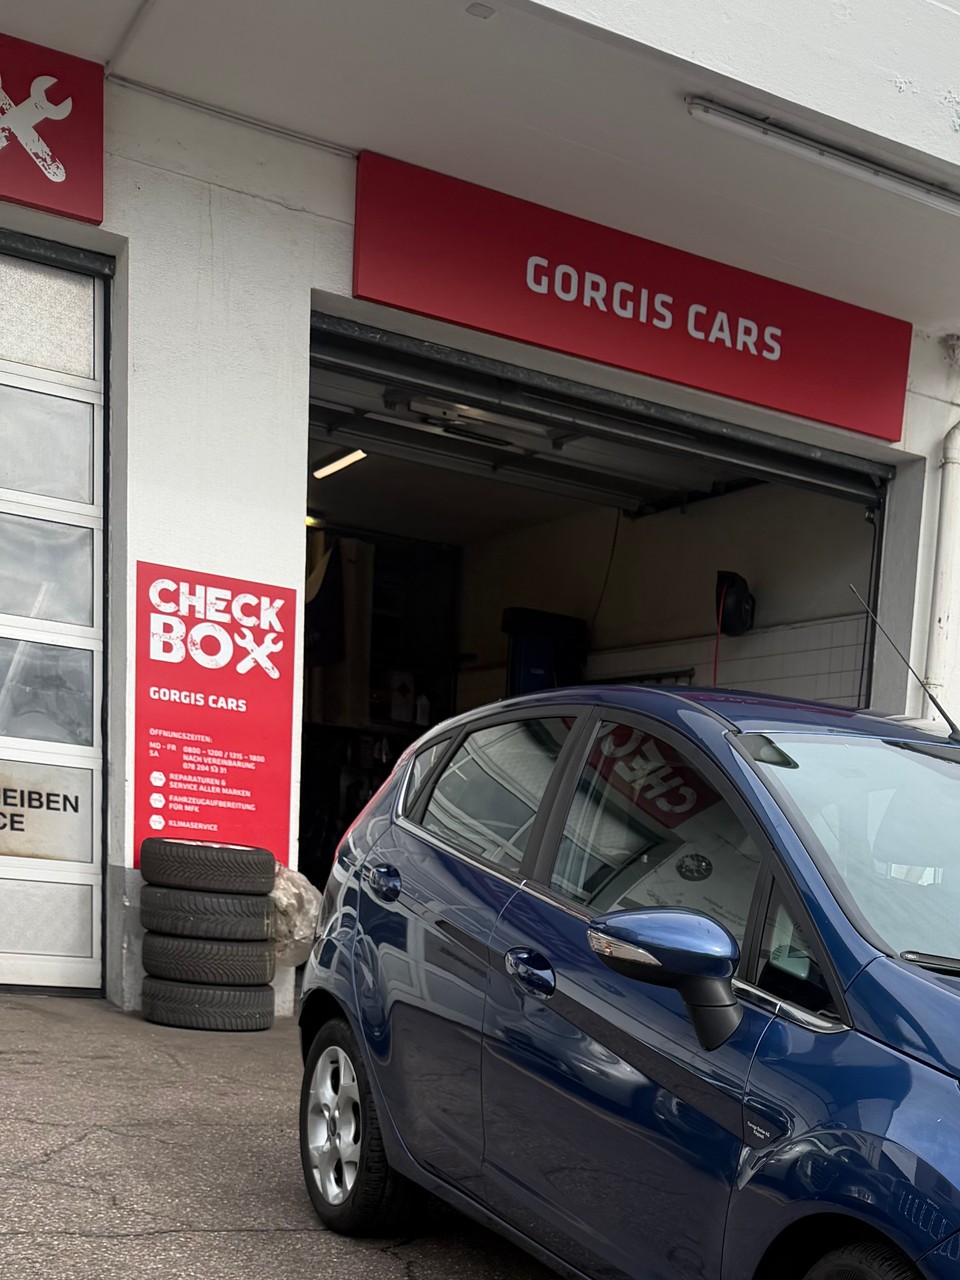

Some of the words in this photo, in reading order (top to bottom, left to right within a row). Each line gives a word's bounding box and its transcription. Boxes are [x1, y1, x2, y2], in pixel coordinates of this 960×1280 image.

[526, 255, 674, 330] GORGIS
[687, 303, 782, 361] CARS
[149, 578, 285, 633] CHECK
[150, 686, 205, 706] GORGIS
[208, 695, 247, 712] CARS
[183, 754, 202, 763] NACH
[203, 756, 256, 770] VEREINBARUNG
[169, 773, 220, 786] REPARATUREN
[169, 781, 198, 791] SERVICE
[199, 785, 221, 794] ALLER
[222, 787, 251, 797] MARKEN
[169, 794, 256, 811] FAHRZEUGAUFBEREITUNG
[168, 819, 218, 832] KLIMASERVICE
